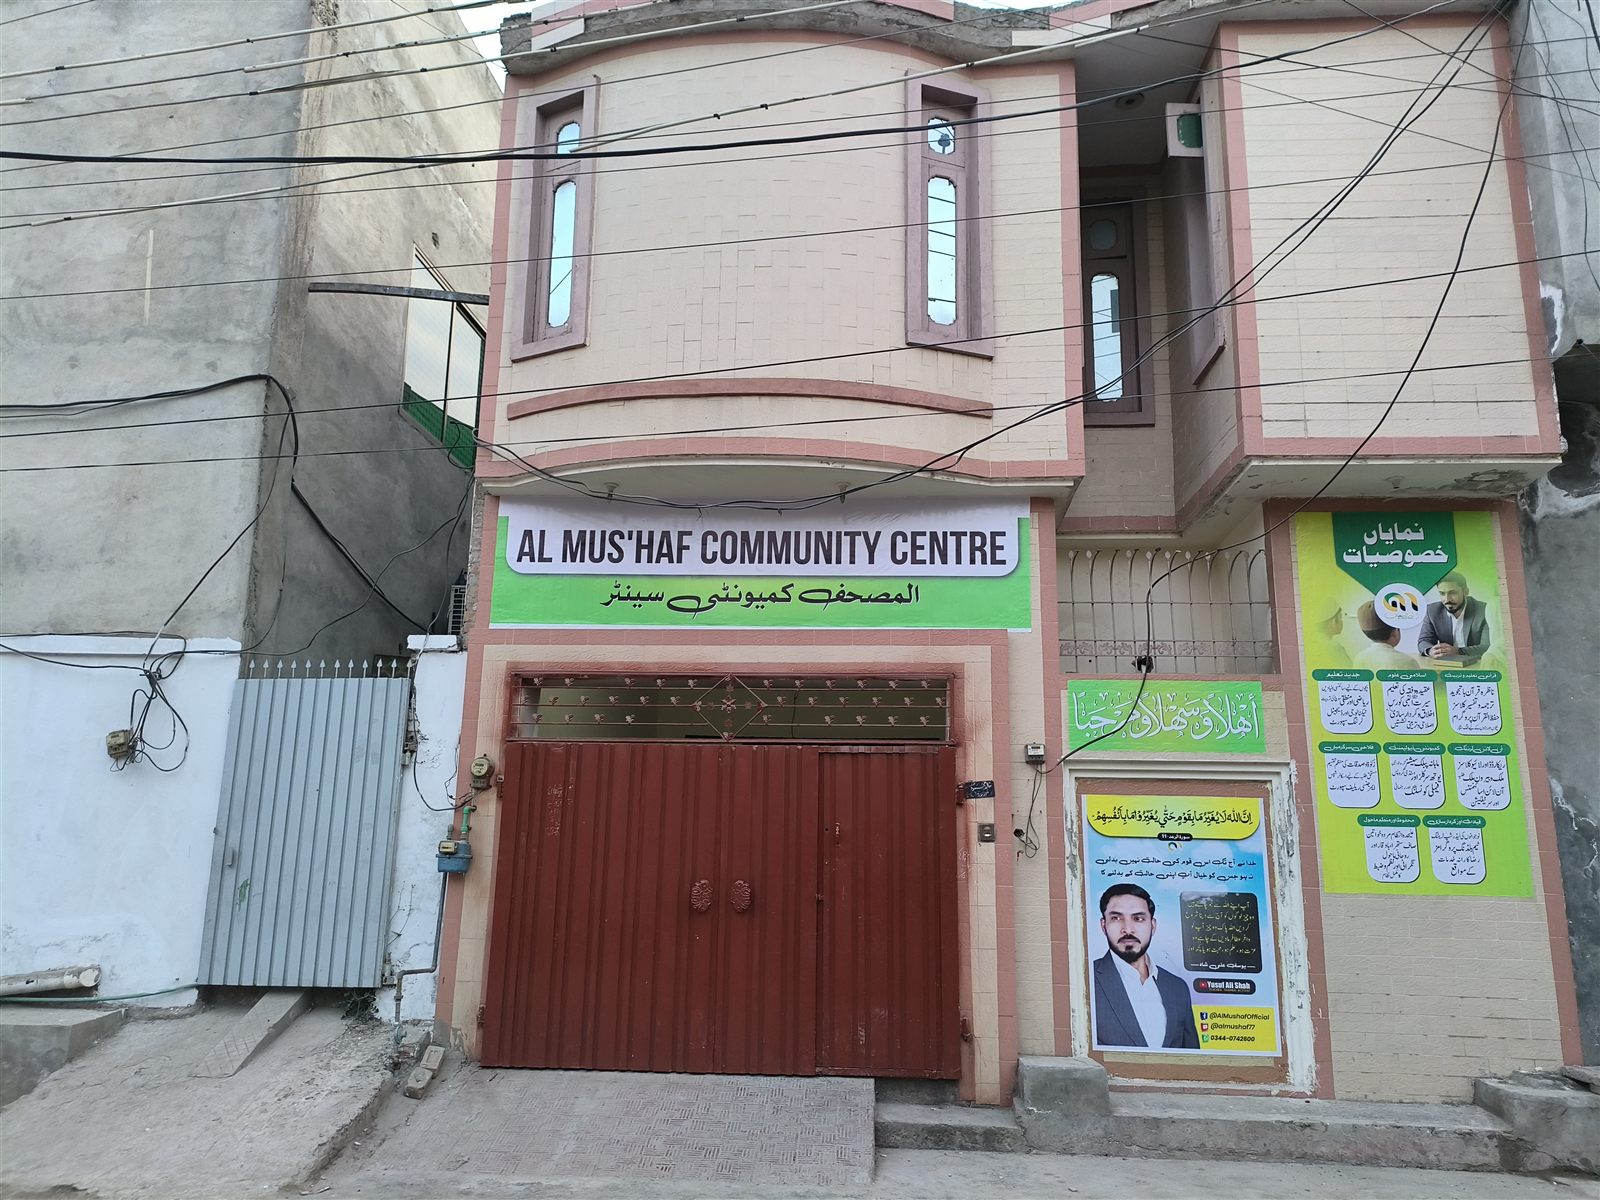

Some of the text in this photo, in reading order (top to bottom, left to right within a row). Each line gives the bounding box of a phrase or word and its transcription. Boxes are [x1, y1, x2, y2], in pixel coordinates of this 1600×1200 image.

[1364, 523, 1424, 544] نمایاں
[516, 529, 1006, 565] AL MUS'HAF COMMUNITY CENTRE
[1343, 545, 1448, 567] خصوصیات
[600, 580, 919, 619] المصحف کمیونٹی سینٹر
[1400, 684, 1406, 695] کی
[1162, 858, 1179, 866] کی
[1228, 858, 1235, 868] آج
[1467, 866, 1476, 875] کے
[1210, 1012, 1270, 1020] @AlMushafOfficial
